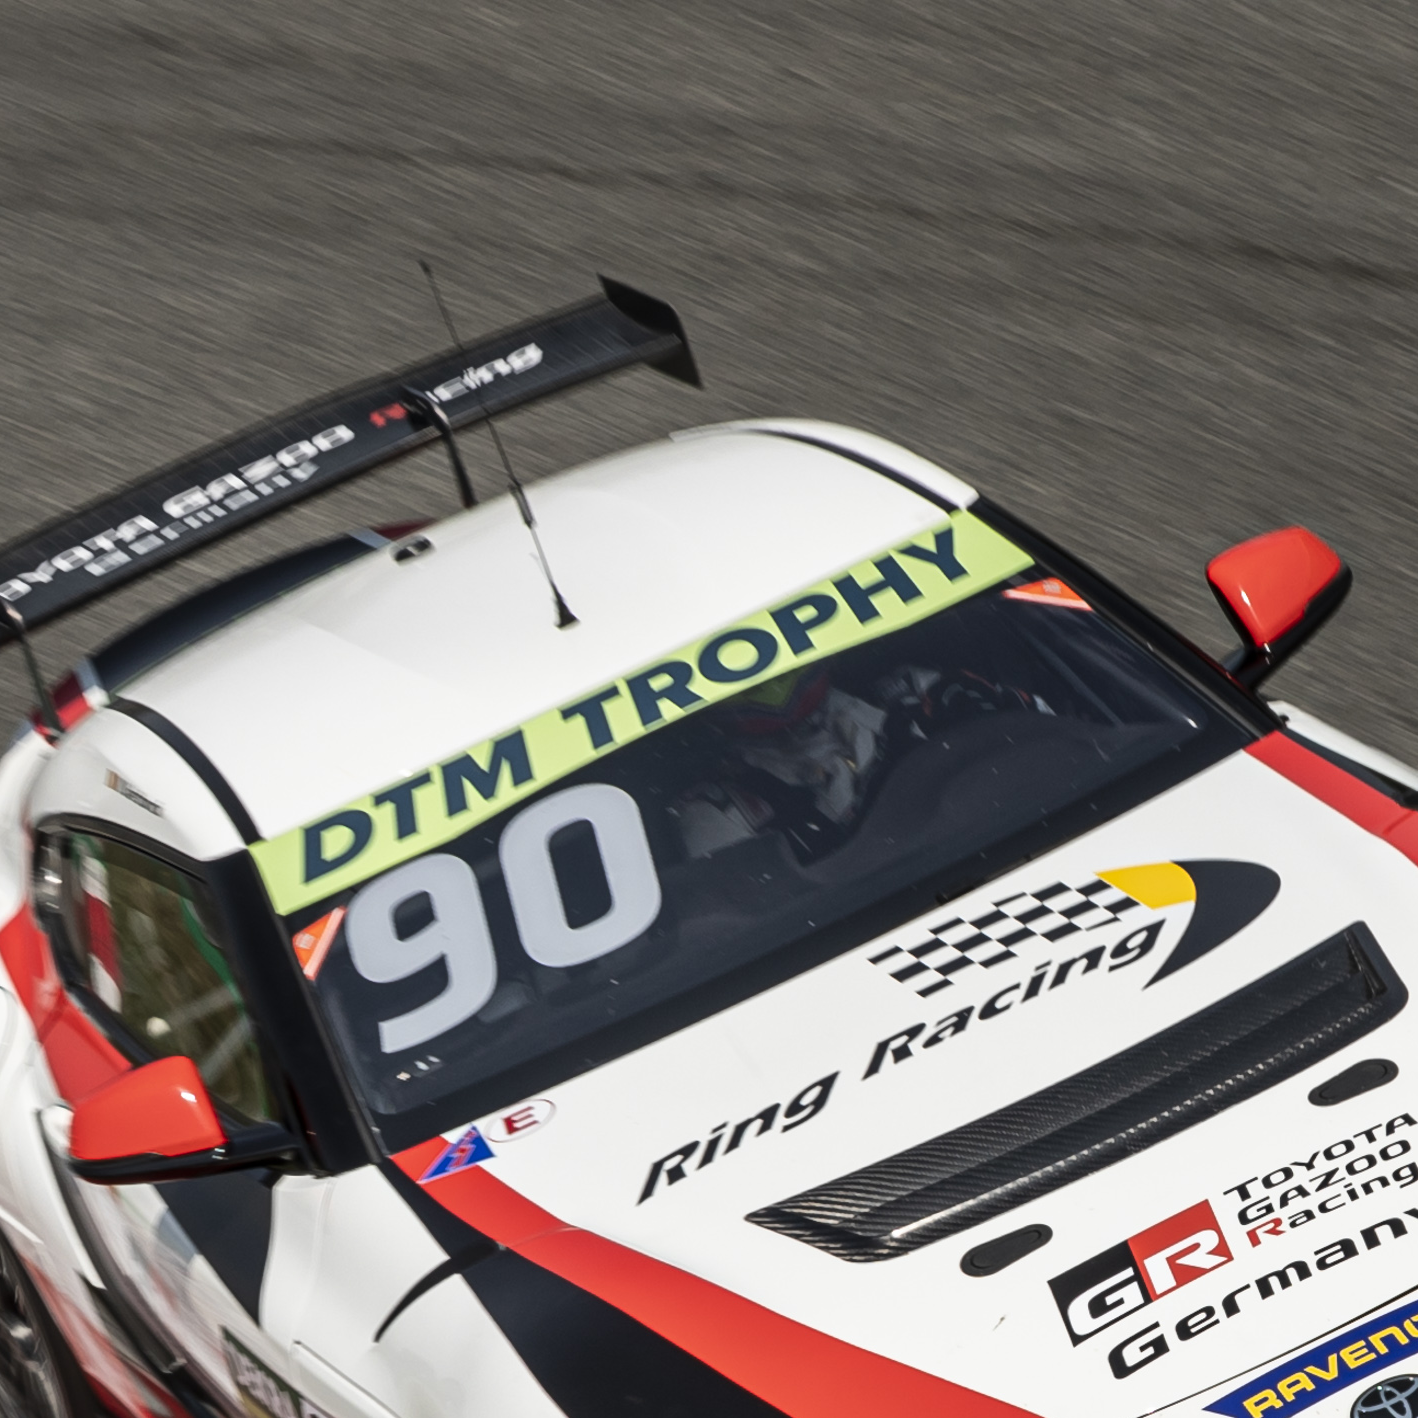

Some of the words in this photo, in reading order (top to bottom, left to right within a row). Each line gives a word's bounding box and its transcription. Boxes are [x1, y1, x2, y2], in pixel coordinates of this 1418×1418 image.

[162, 424, 355, 519] GAZOO
[300, 728, 536, 884] DTM
[560, 526, 969, 754] TROPHY
[344, 783, 663, 1054] 90
[636, 1070, 841, 1207] Ring
[861, 918, 1167, 1081] Racing
[503, 1105, 542, 1136] E
[1222, 1112, 1418, 1202] TOYOTA
[1236, 1138, 1412, 1226] GAZOO
[1067, 1228, 1229, 1337] GR
